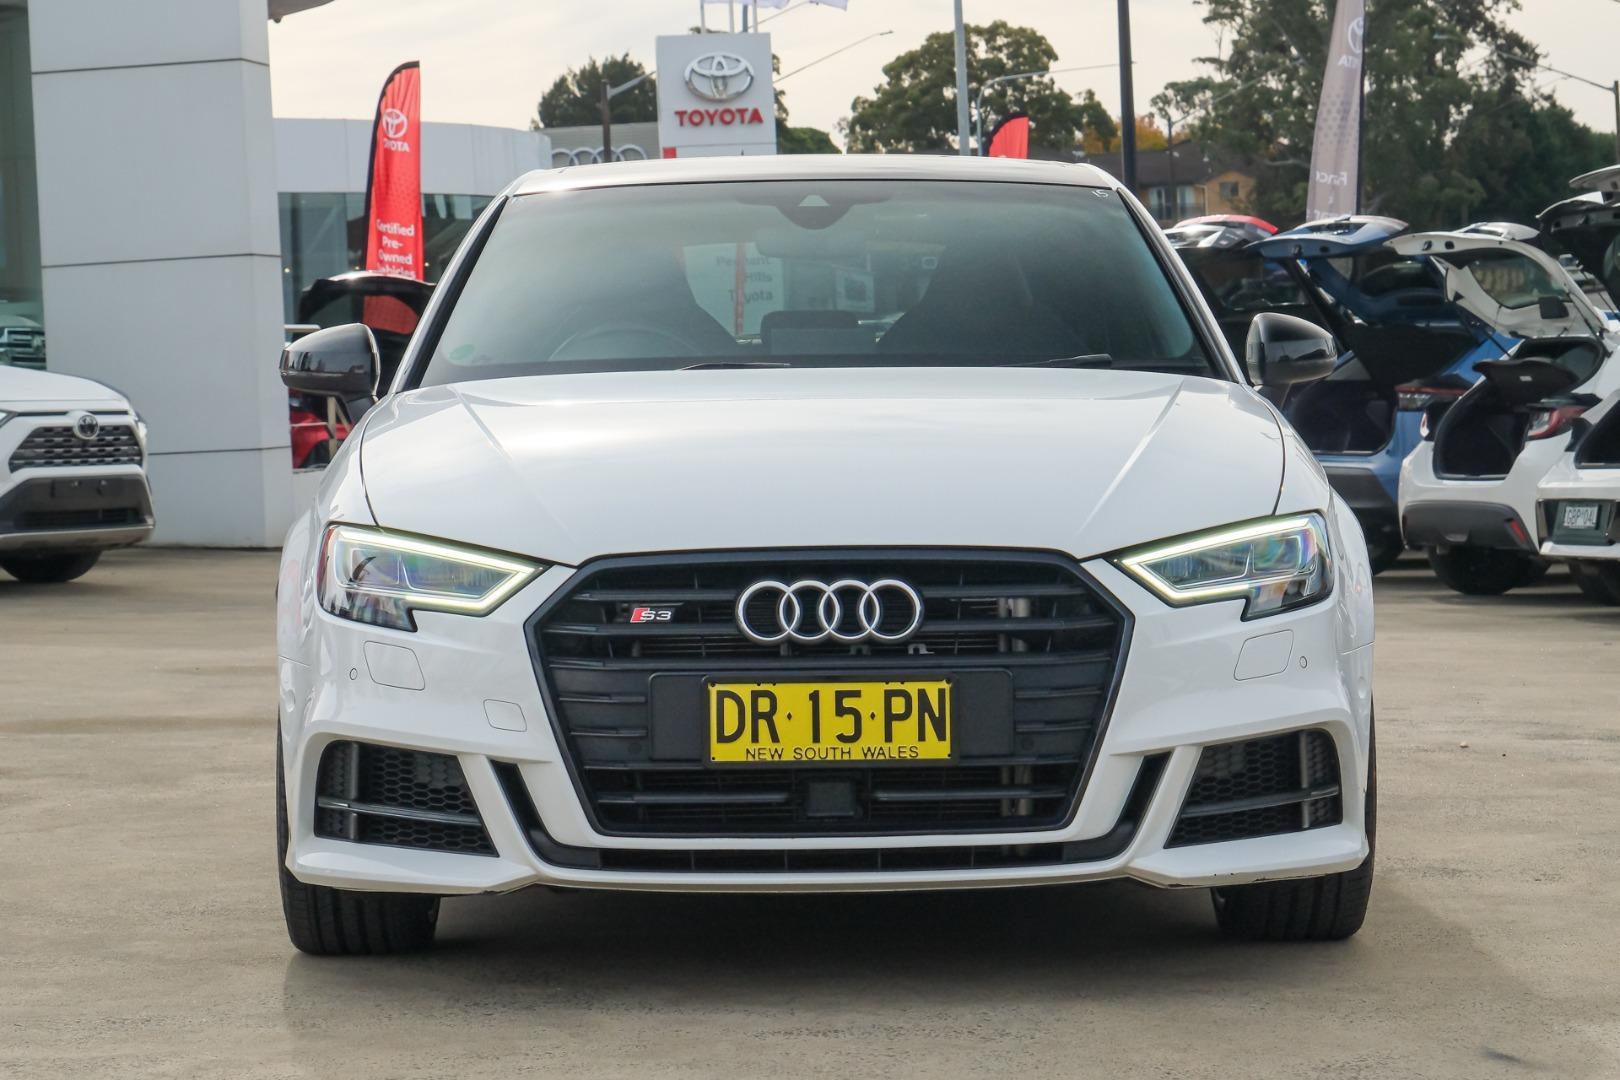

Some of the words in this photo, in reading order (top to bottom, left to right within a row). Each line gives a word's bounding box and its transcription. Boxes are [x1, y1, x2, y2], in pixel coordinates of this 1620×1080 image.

[674, 107, 764, 127] TOYOTA
[376, 218, 416, 237] Certified
[382, 235, 405, 249] Pre-
[378, 249, 413, 266] Owned
[728, 288, 774, 304] Tyota
[638, 609, 672, 621] S3
[745, 746, 784, 760] NEW
[793, 746, 851, 760] SOUTH
[861, 745, 919, 759] WALES
